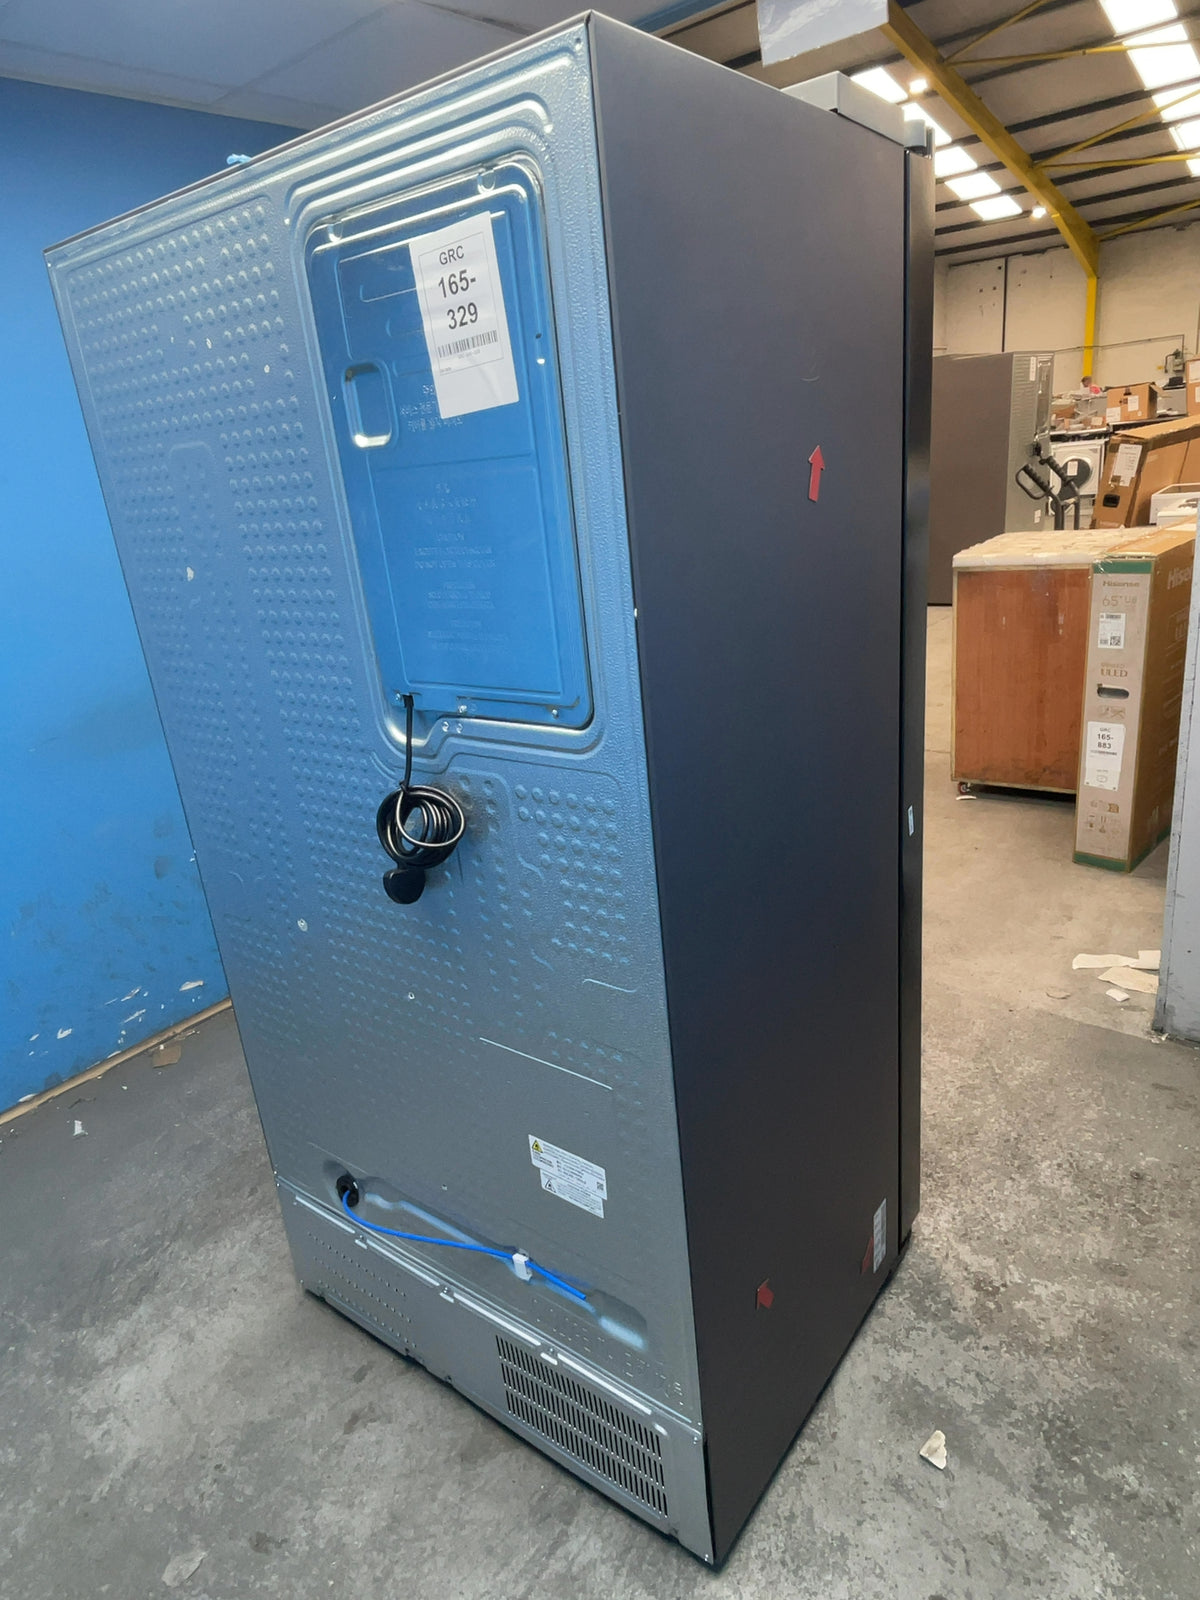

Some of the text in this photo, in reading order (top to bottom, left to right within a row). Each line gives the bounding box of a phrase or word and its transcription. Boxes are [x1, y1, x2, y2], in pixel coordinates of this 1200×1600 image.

[438, 245, 465, 265] GRC
[438, 269, 477, 299] 165-
[446, 302, 479, 330] 329
[1100, 668, 1129, 678] ULED
[1097, 733, 1114, 741] 165-
[1097, 741, 1112, 749] 883
